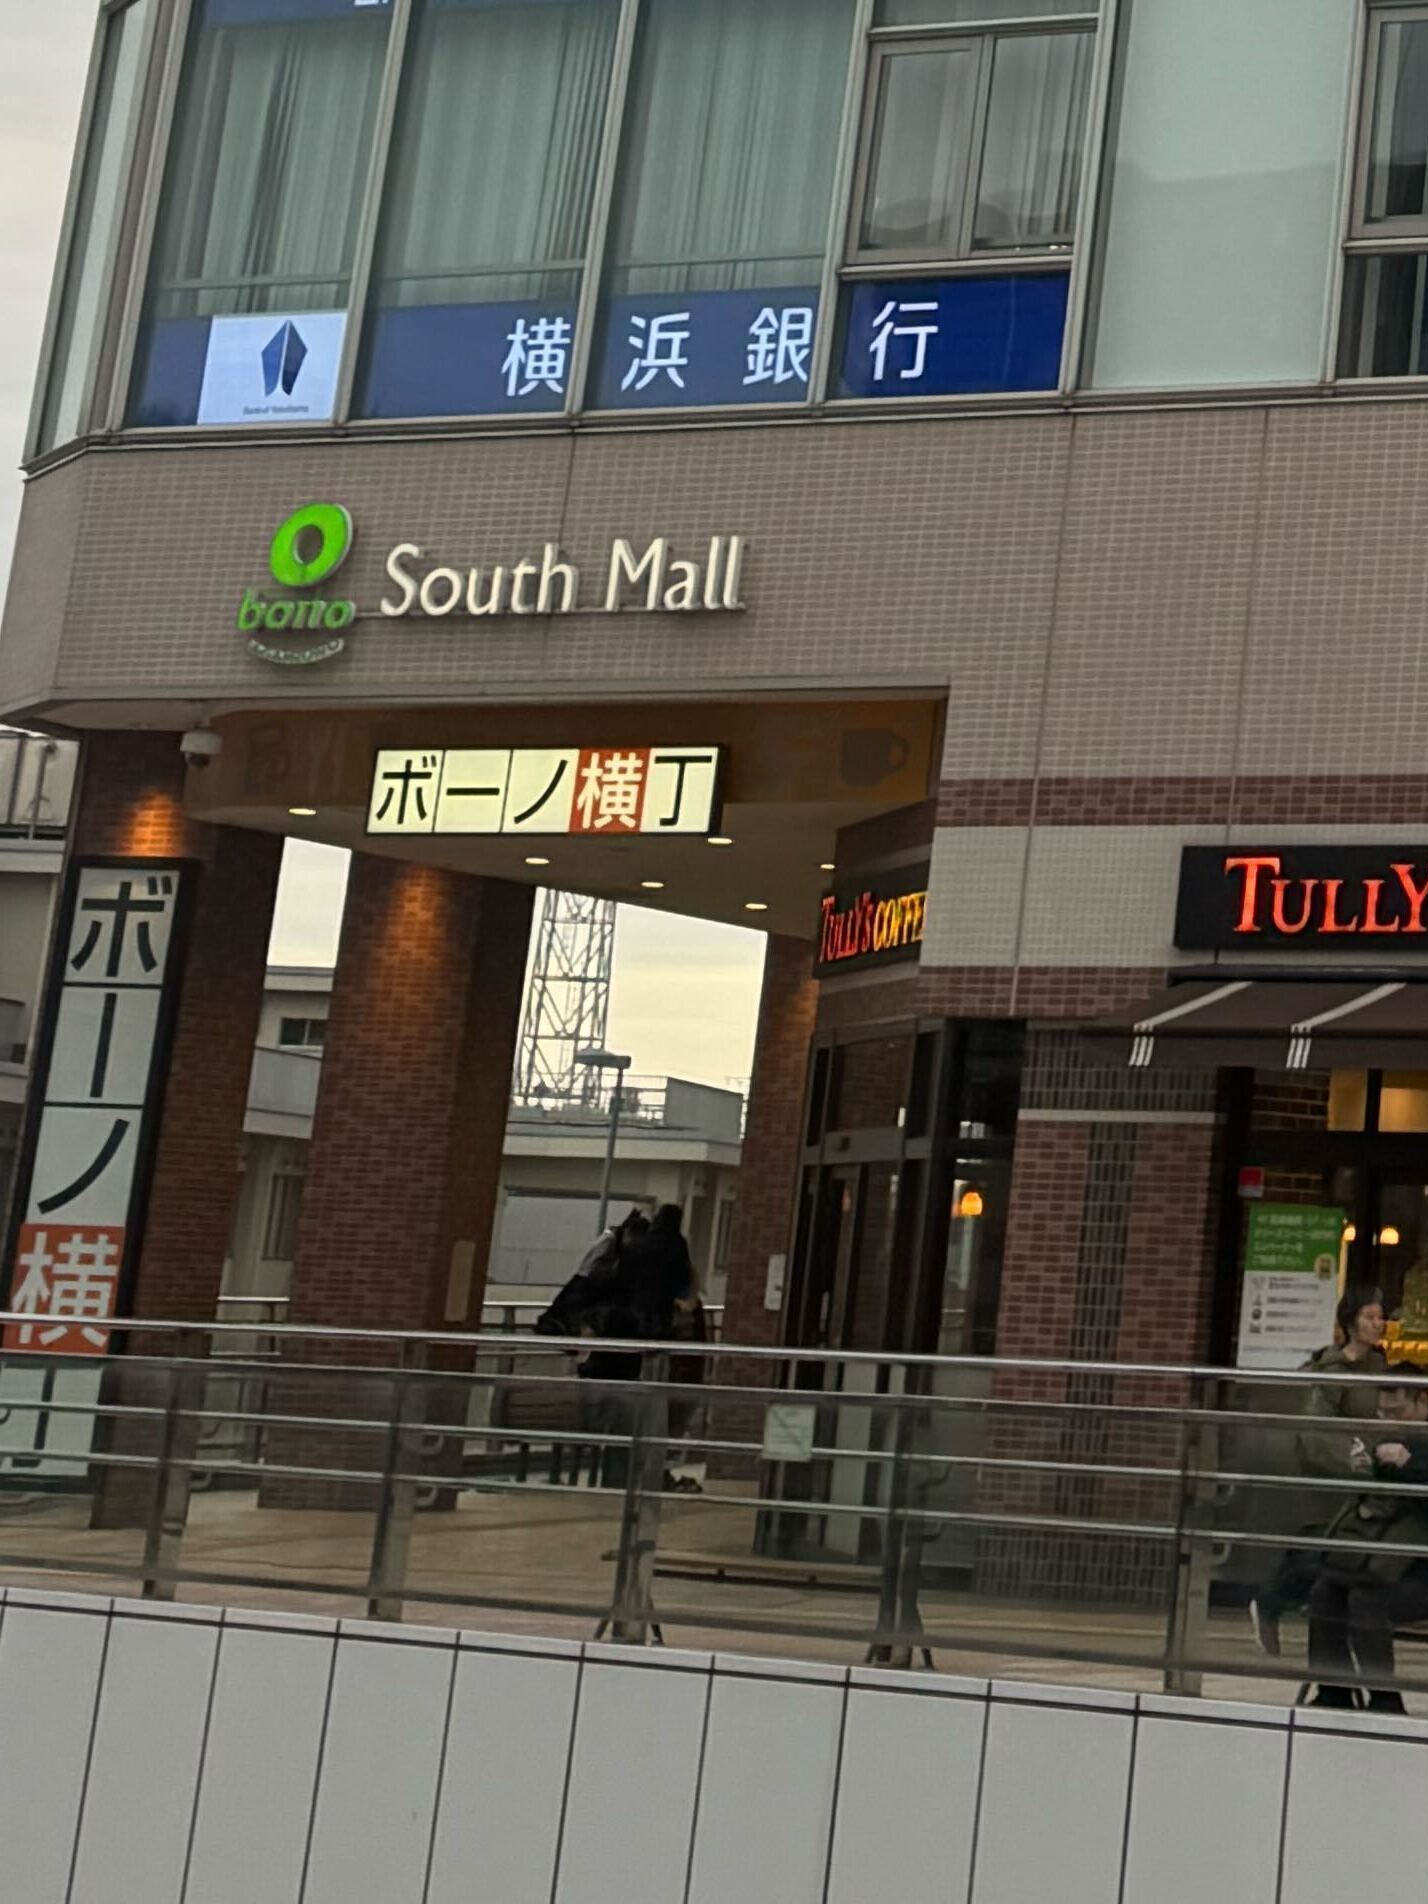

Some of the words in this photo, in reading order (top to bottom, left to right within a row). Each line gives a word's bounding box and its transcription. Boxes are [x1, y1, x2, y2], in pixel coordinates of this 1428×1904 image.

[501, 301, 938, 396] 横浜銀行
[380, 542, 579, 617] South
[605, 535, 744, 613] Mall
[374, 752, 714, 830] ボーノ横丁
[873, 892, 928, 952] COFFE
